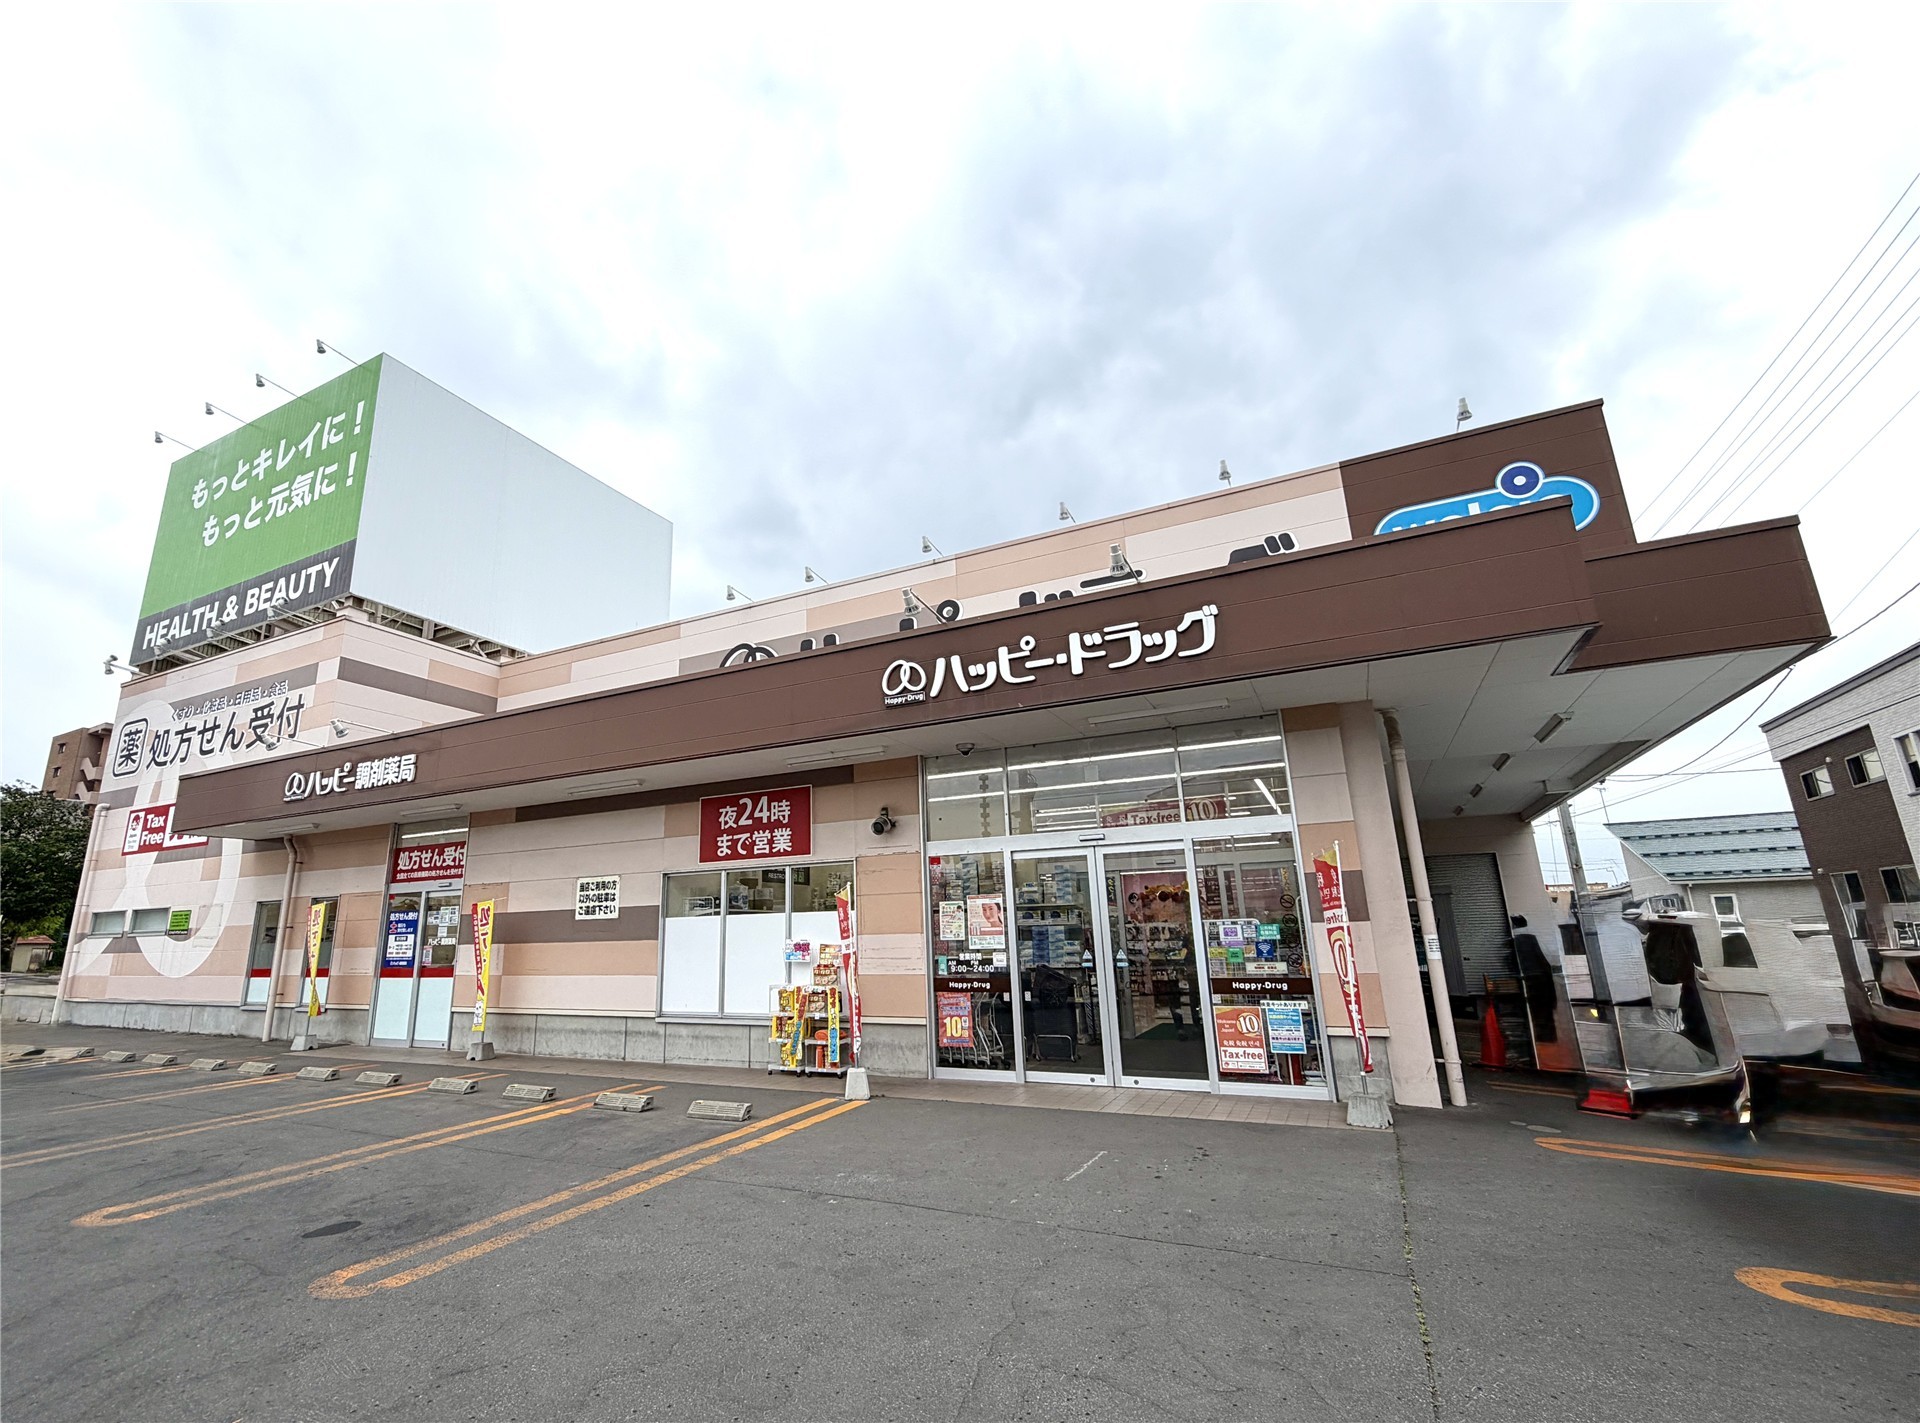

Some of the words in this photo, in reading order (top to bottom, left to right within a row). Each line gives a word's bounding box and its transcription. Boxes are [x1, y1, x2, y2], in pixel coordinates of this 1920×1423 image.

[142, 602, 219, 650] HEALTH
[222, 595, 240, 623] &
[243, 557, 340, 617] BEAUTY
[118, 728, 144, 773] 薬
[146, 694, 305, 770] 処方せん受付
[303, 754, 417, 797] ハッピー調剤薬局
[146, 814, 166, 828] Tax
[718, 795, 791, 830] 夜24時
[1130, 812, 1181, 825] Tax-free
[1189, 800, 1217, 820] 10
[140, 831, 164, 845] Free
[716, 827, 792, 857] まで営業
[396, 845, 467, 871] 処方せん受付
[579, 880, 617, 893] 当店ご利用の方
[578, 892, 617, 904] 以外の駐車は
[577, 904, 616, 916] ご遠慮下さい
[1237, 1014, 1260, 1034] 10
[1222, 1049, 1264, 1060] Tax-free
